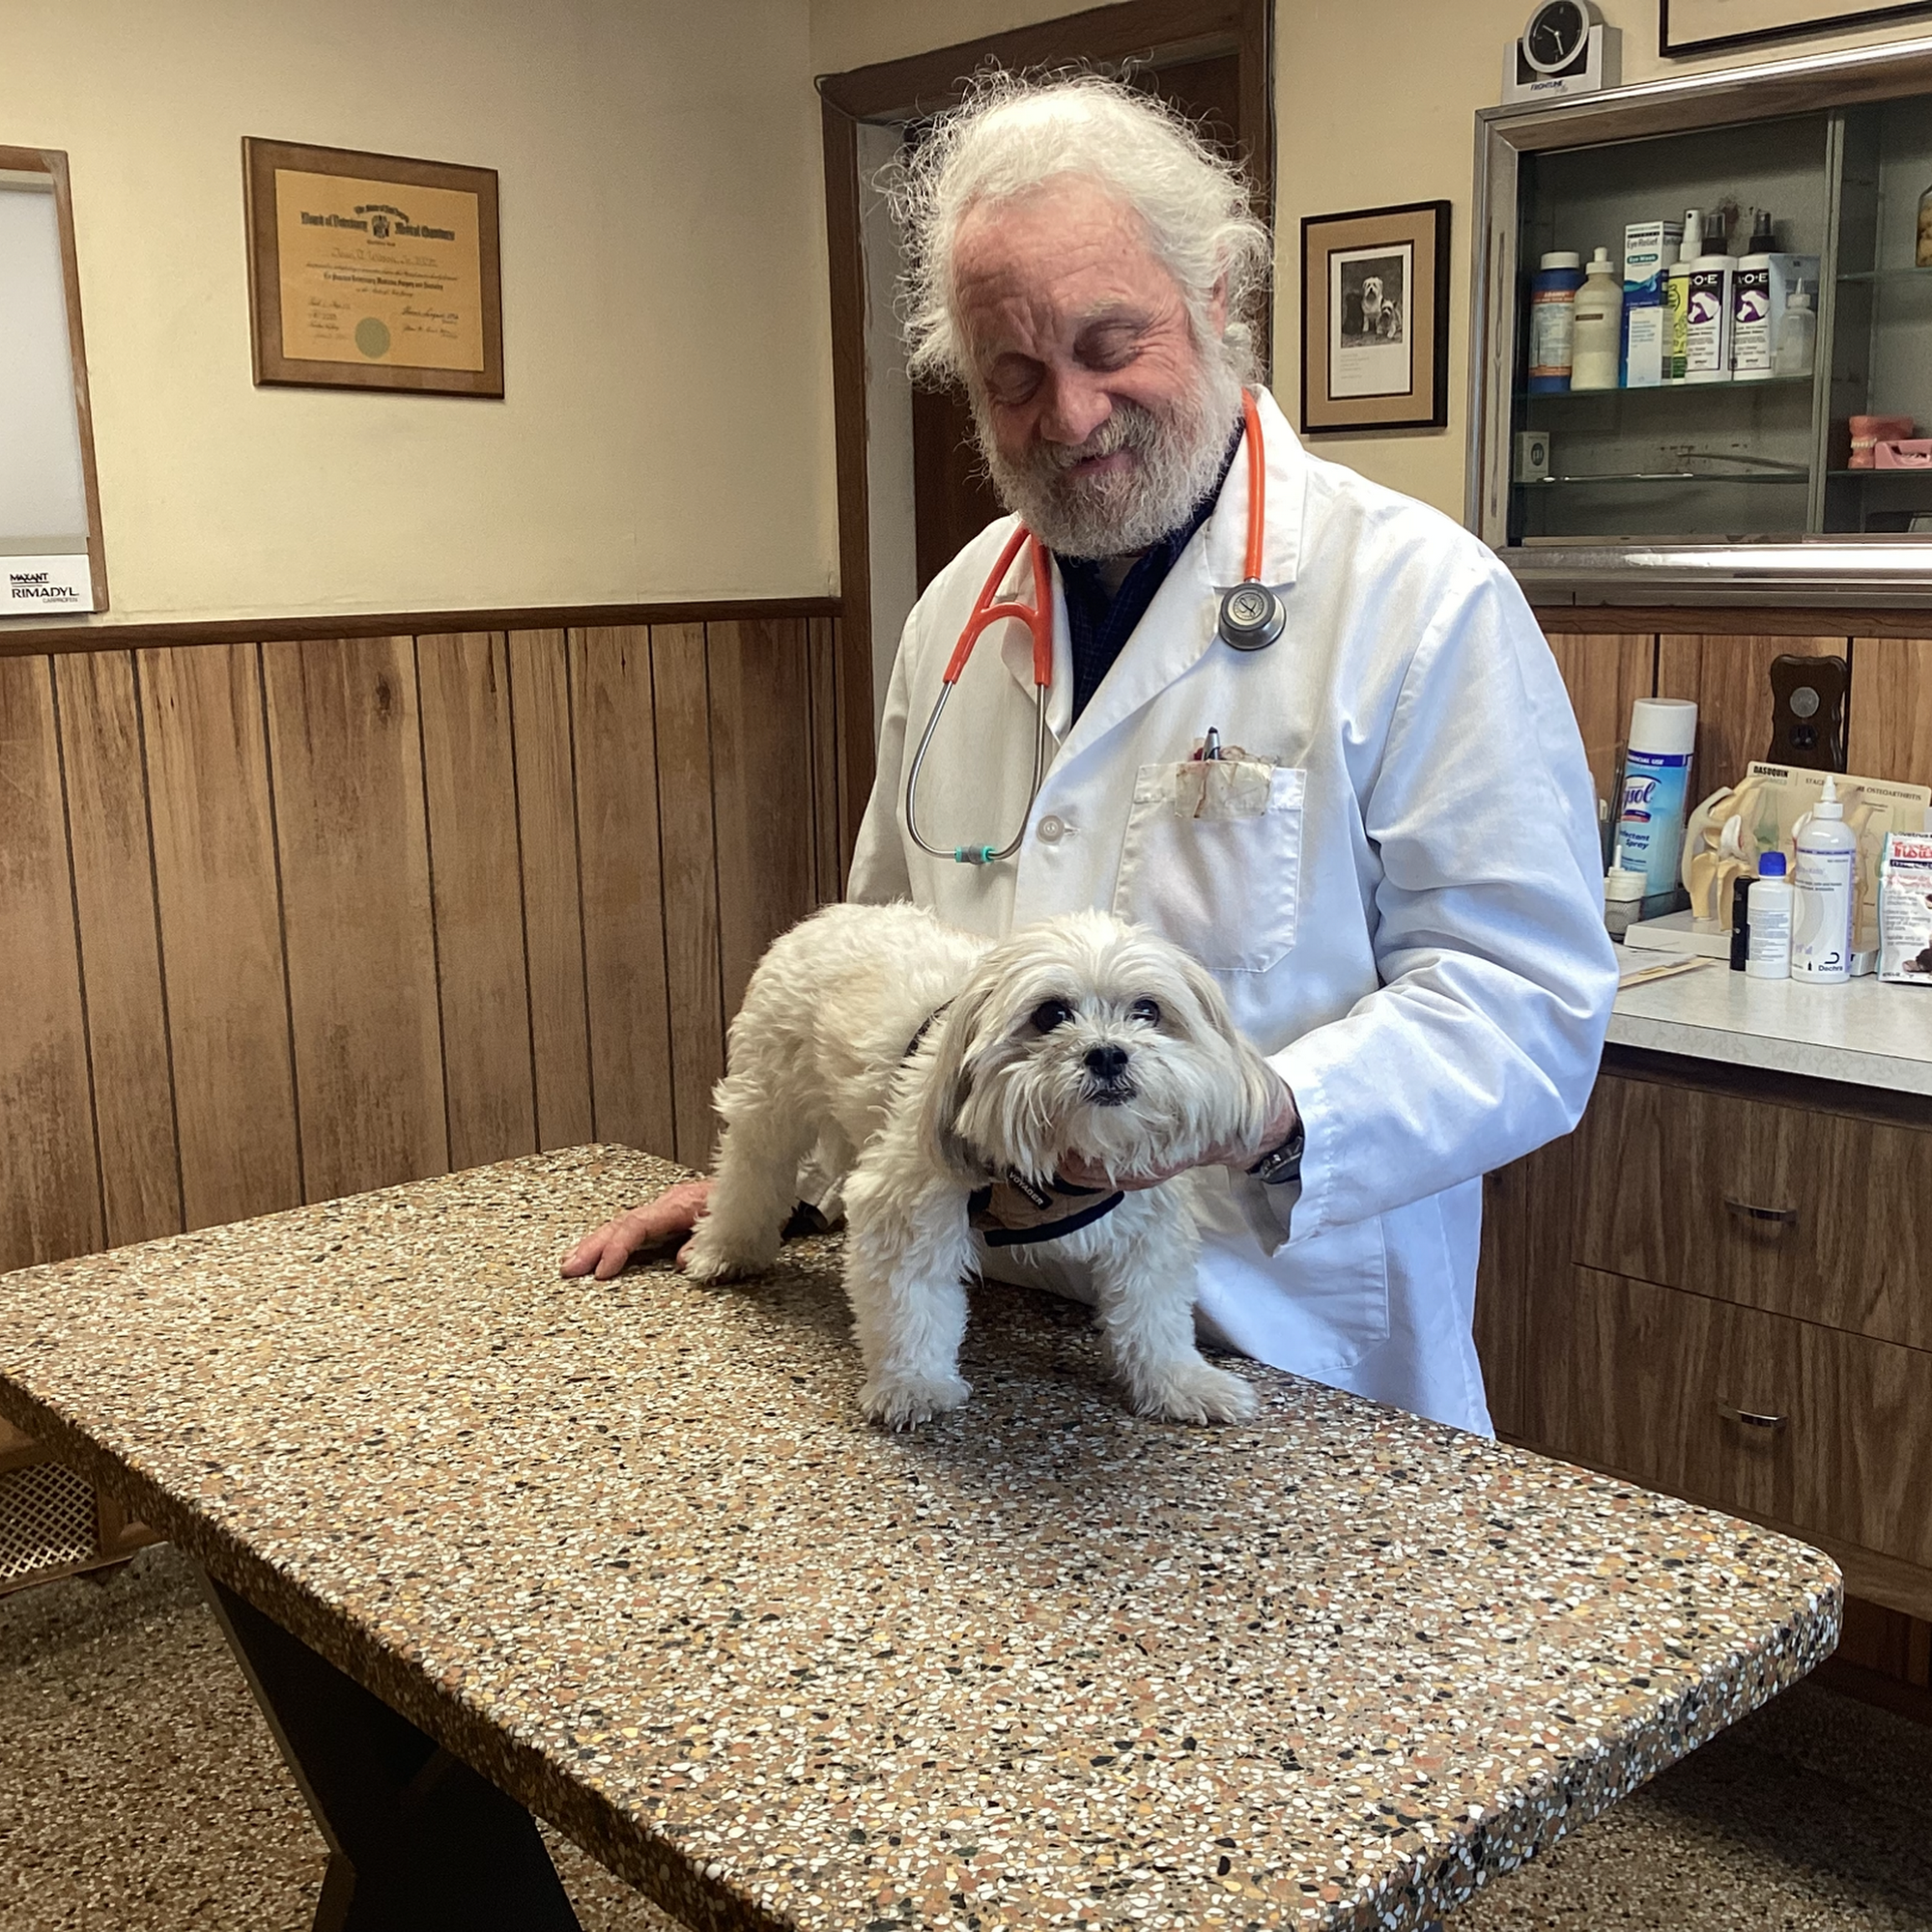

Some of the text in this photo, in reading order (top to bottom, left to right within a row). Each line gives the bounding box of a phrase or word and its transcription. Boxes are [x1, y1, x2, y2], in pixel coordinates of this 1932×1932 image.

[12, 587, 79, 598] RIMADYL
[1753, 765, 1789, 778] DASUQUIN
[1866, 786, 1922, 801] OSTEOARTHRITIS
[1626, 838, 1650, 850] Spray
[1009, 1171, 1044, 1206] VOYAGER
